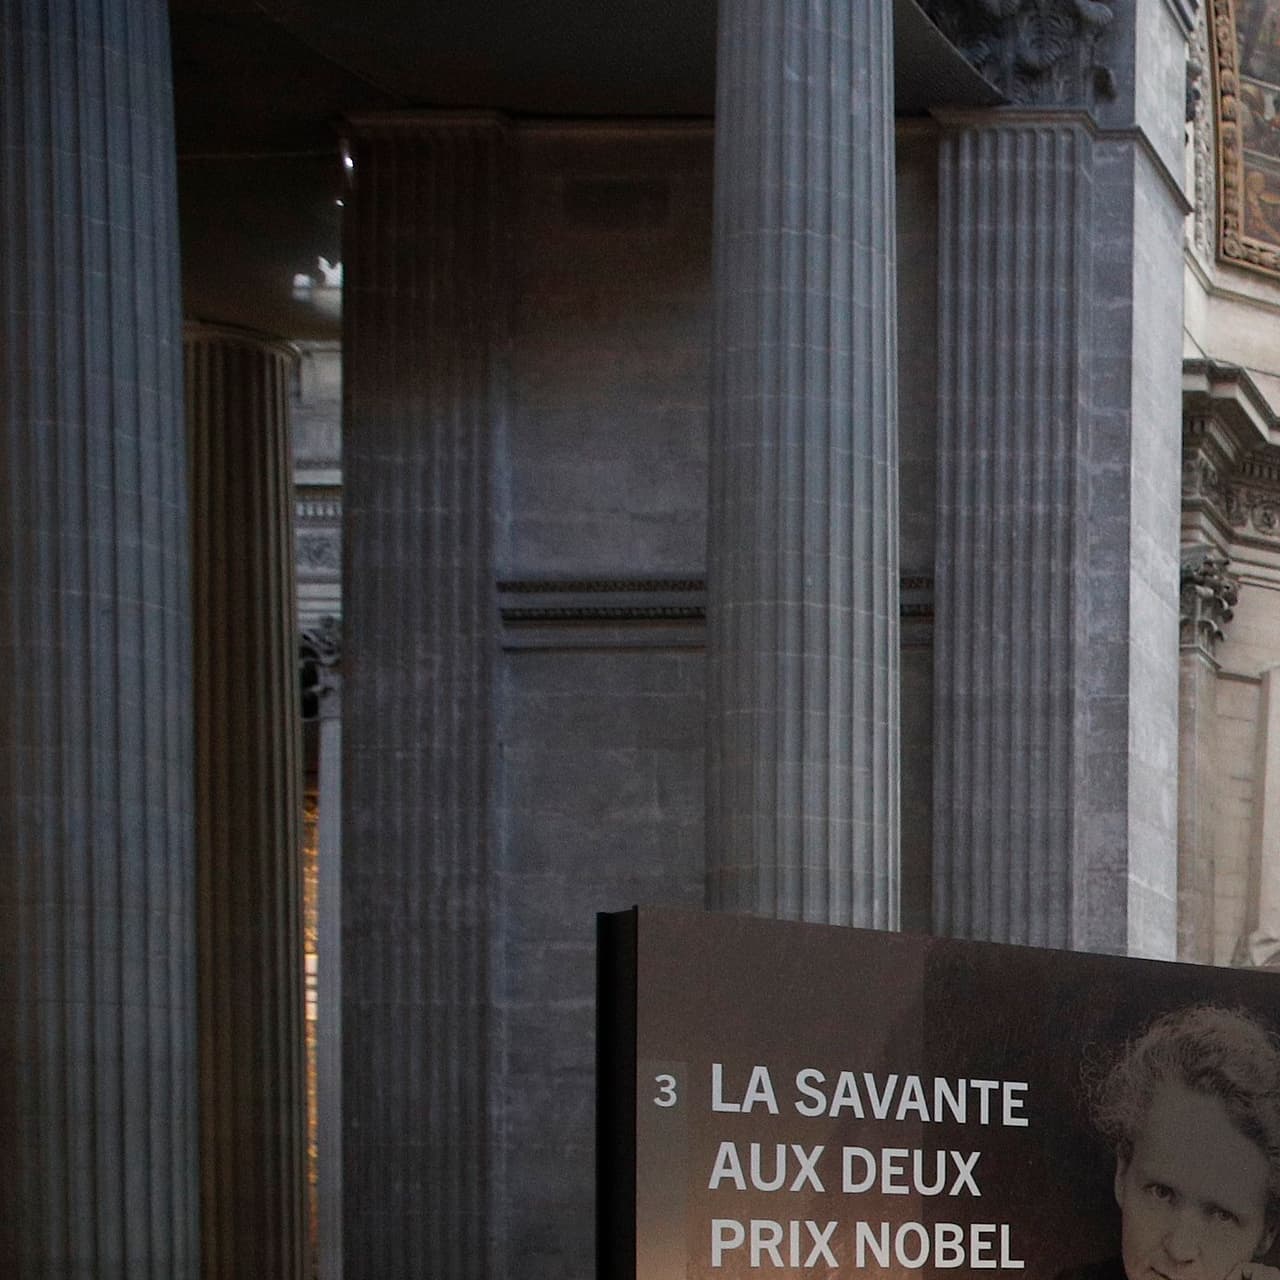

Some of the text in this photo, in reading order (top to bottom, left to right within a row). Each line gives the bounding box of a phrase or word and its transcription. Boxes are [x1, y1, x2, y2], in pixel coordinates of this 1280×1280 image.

[653, 1074, 677, 1107] 3
[712, 1063, 1029, 1127] LA SAVANTE
[708, 1141, 982, 1196] AUX DEUX
[711, 1219, 1025, 1269] PRIX NOBEL
